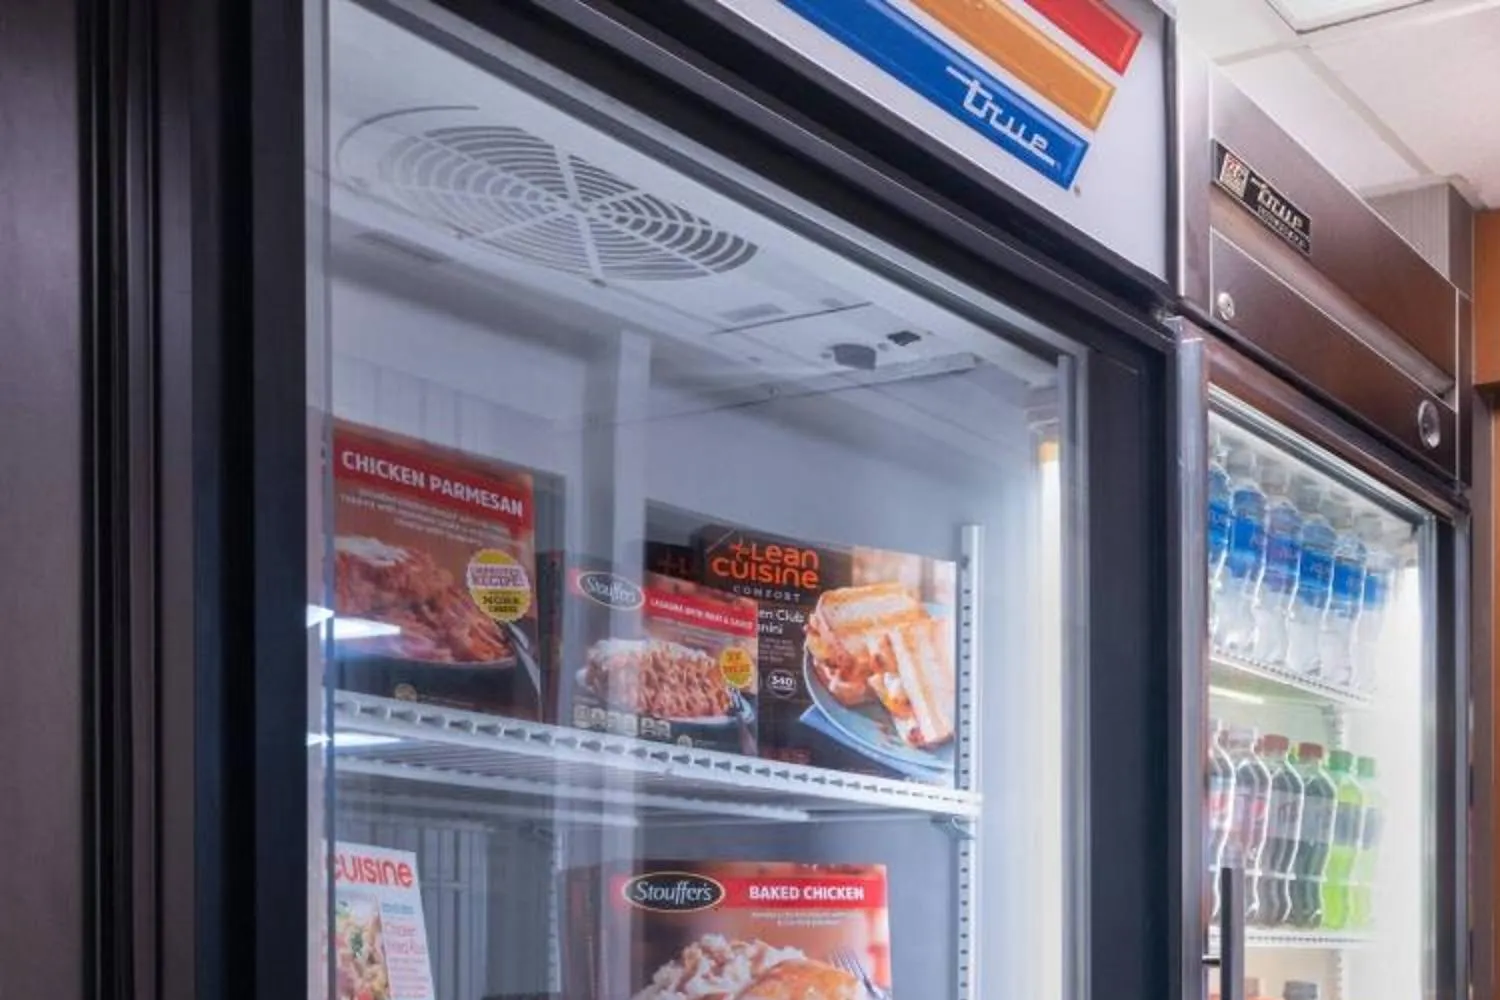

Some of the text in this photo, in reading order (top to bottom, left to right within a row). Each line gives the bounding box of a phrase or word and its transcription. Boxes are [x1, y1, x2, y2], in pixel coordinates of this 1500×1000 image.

[945, 66, 1056, 168] true
[341, 450, 524, 517] CHICKEN PARMESAN
[733, 585, 800, 601] COMFORT
[634, 881, 712, 905] Stouffer's
[749, 886, 864, 900] BAKED CHICKEN
